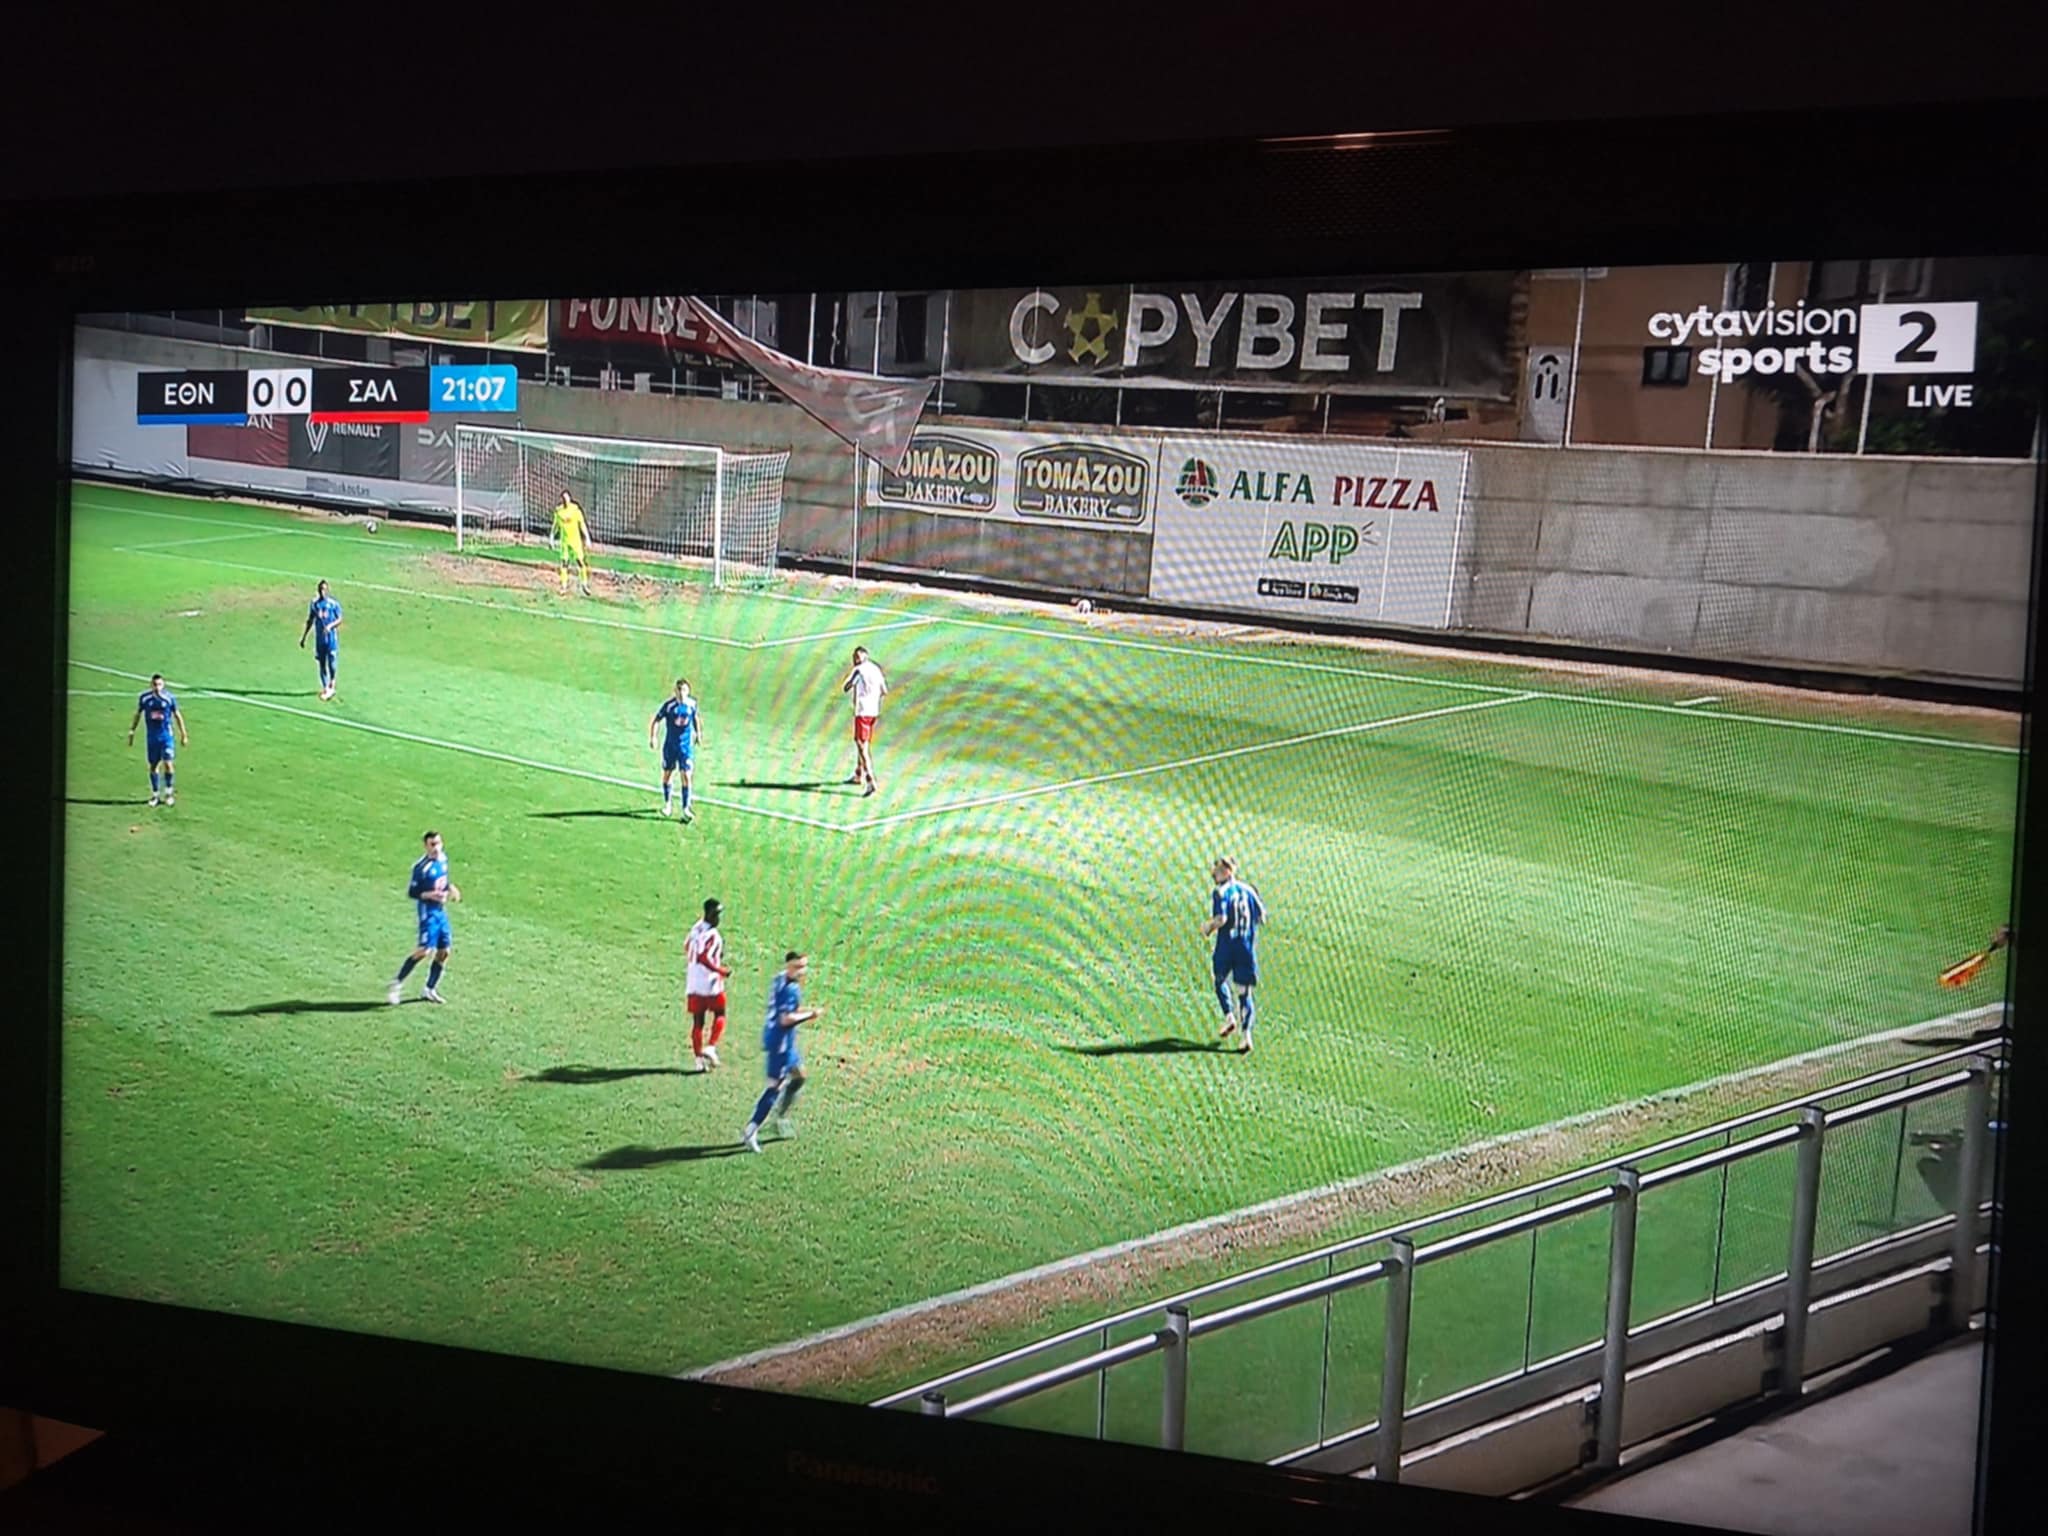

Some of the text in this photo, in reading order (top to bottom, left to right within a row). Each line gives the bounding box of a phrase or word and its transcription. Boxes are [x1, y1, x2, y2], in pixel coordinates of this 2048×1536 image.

[1648, 300, 1857, 345] cytavision
[1895, 311, 1938, 363] 2
[1697, 341, 1852, 383] sports
[442, 377, 506, 402] 21:07
[1907, 385, 1973, 407] LIVE
[332, 421, 383, 438] RENAULT
[899, 446, 992, 484] OMAZOU
[1023, 457, 1141, 496] TOMAZOU
[905, 481, 965, 504] BAKERY
[1045, 494, 1111, 518] BAKERY
[1229, 470, 1439, 512] ALFA PIZZA
[1269, 521, 1358, 563] APP
